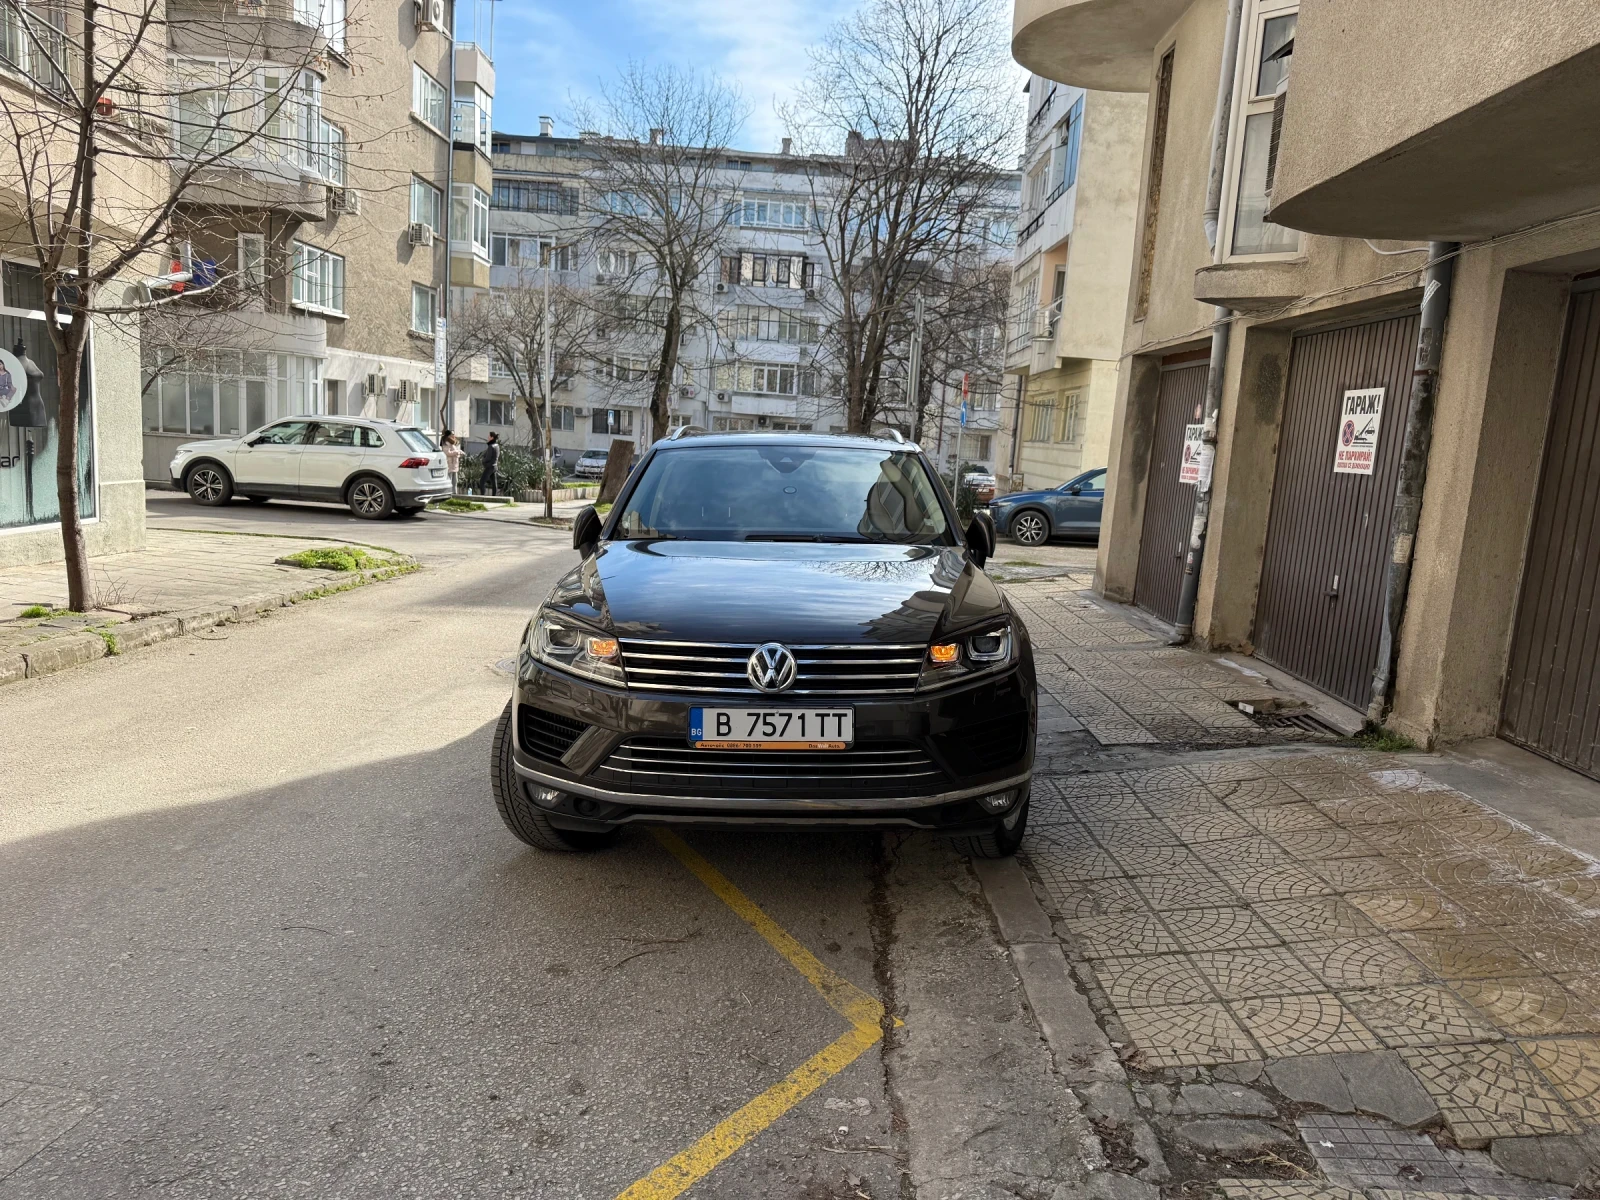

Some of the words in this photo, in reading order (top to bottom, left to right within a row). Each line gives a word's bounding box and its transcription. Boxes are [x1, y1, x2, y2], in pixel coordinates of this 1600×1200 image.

[1344, 394, 1381, 415] ГАРАЖ!
[0, 455, 20, 468] ar
[1338, 450, 1345, 461] НЕ
[1345, 449, 1372, 462] ПАРКИРАЙ!
[716, 712, 732, 737] B
[746, 712, 806, 738] 7571
[815, 712, 848, 738] TT
[691, 728, 702, 736] BG
